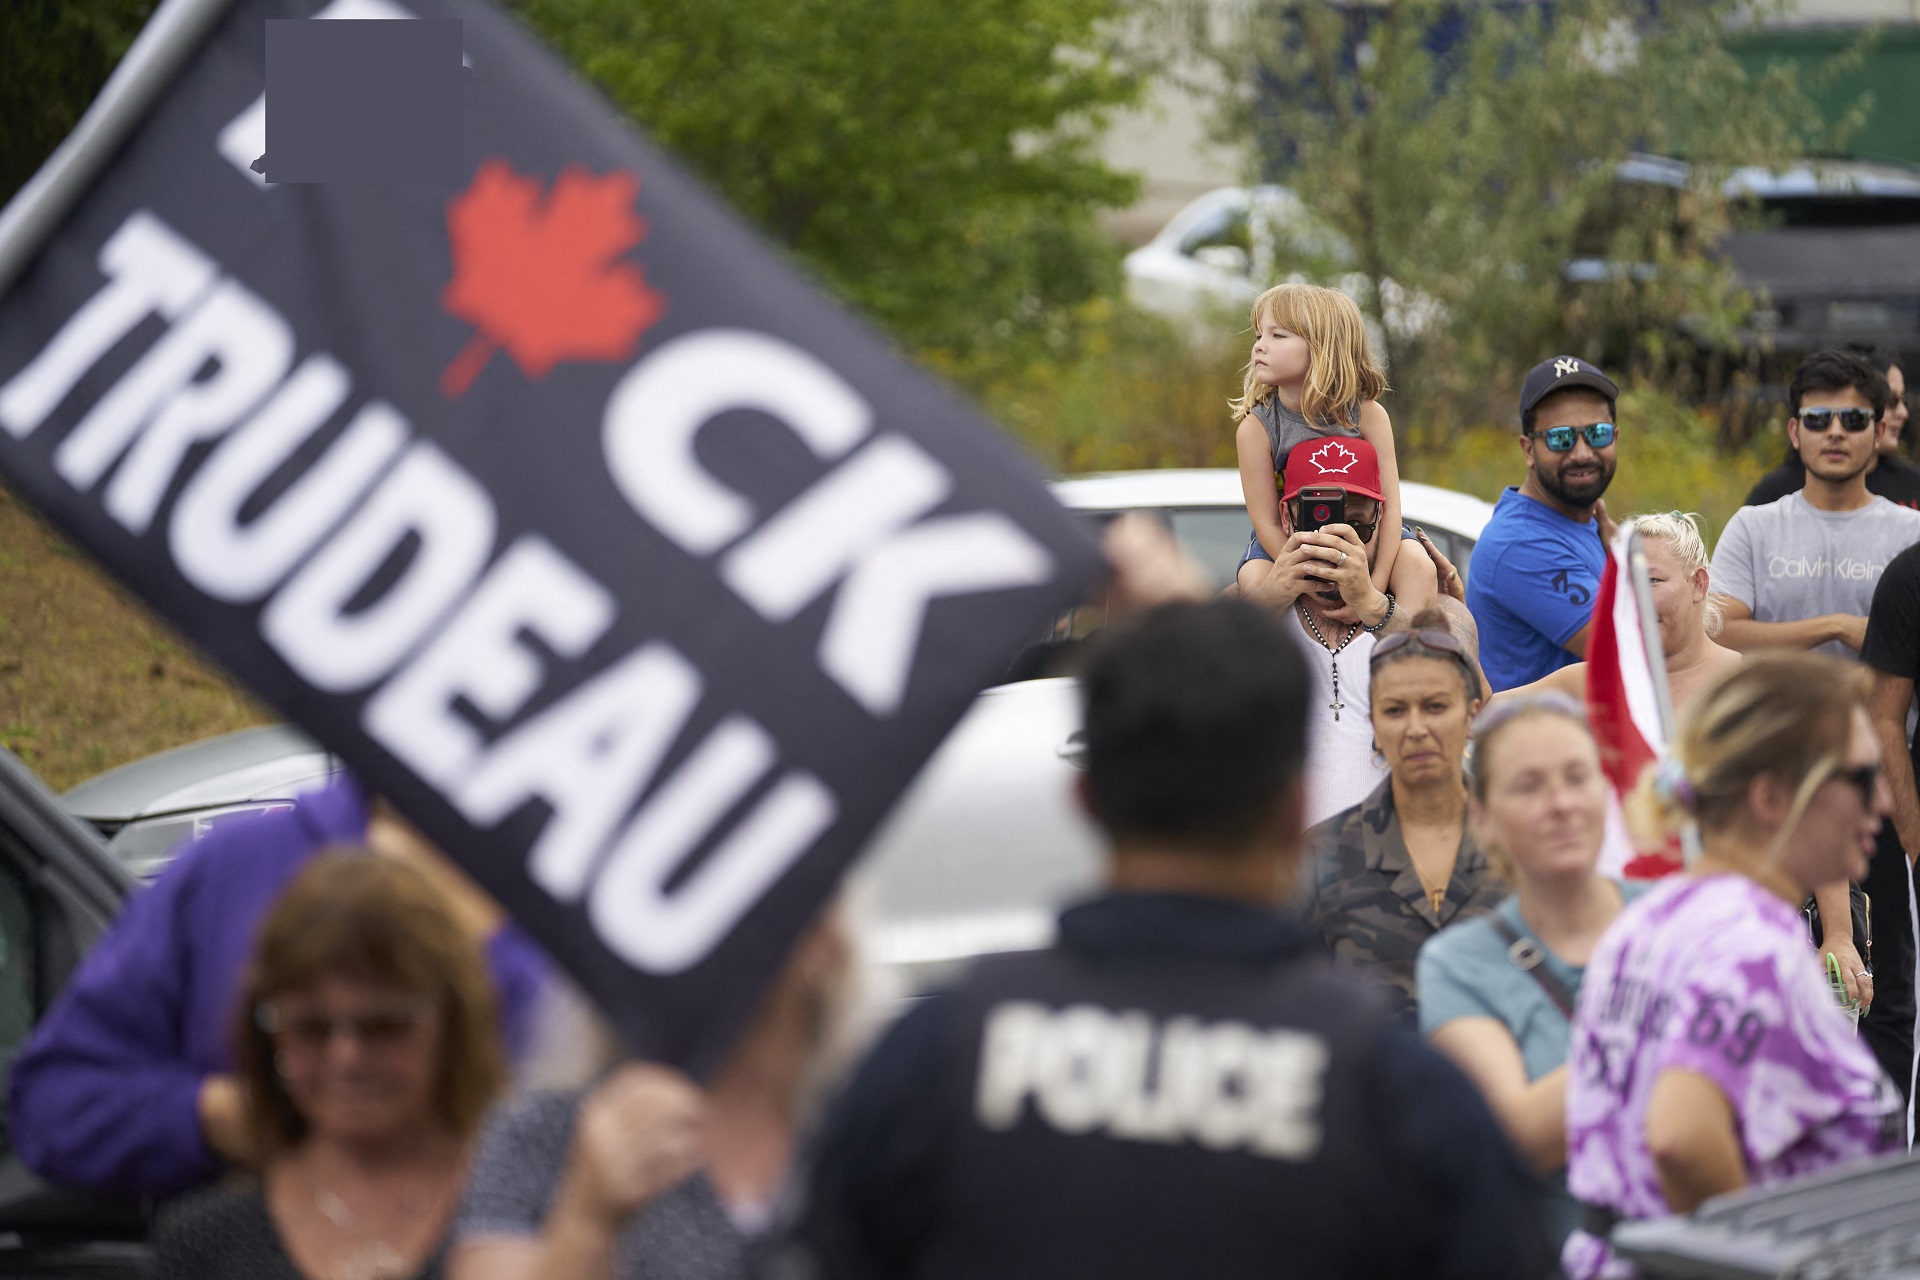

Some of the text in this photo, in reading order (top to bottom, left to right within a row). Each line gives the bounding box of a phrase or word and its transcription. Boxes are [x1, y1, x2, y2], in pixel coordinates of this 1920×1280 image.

[1553, 357, 1579, 378] NY
[0, 212, 835, 973] TRUDEAU
[1768, 555, 1885, 581] Calvin Klein
[978, 1003, 1328, 1160] POLICE
